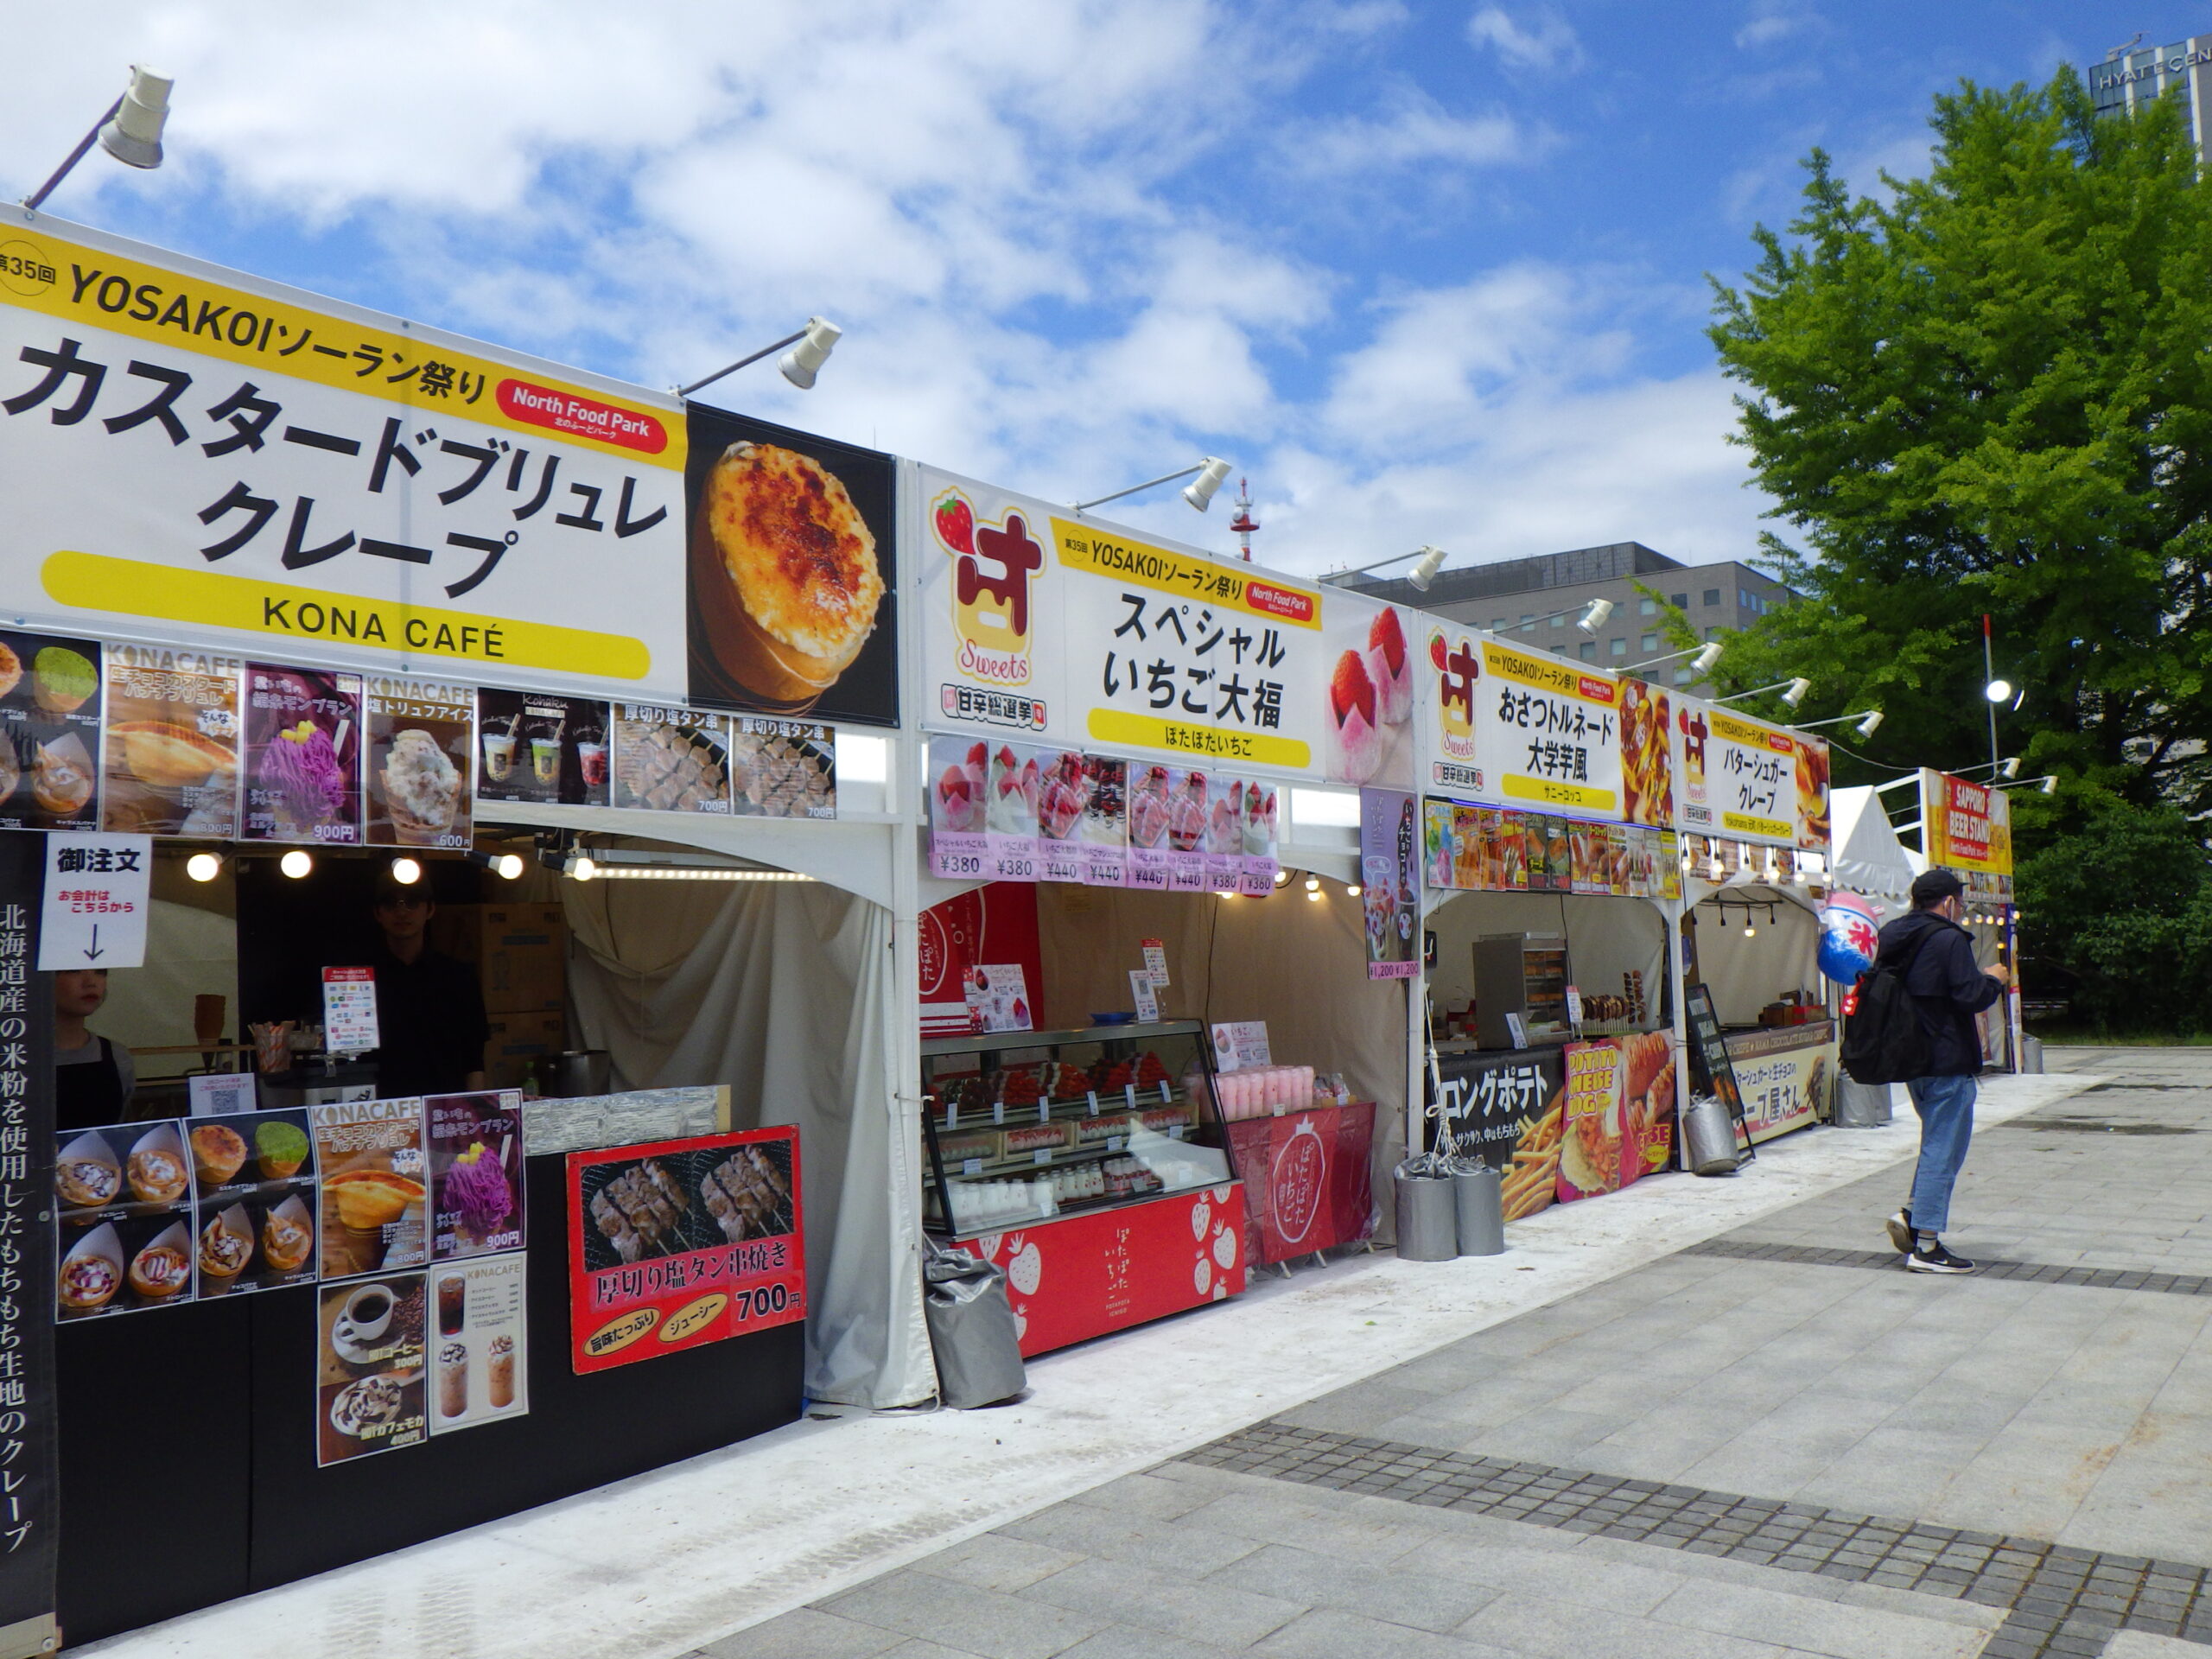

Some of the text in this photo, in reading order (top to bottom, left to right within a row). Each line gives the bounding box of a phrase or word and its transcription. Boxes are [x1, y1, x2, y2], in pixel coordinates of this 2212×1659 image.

[71, 263, 486, 405] YOSAKOIソーラン祭り
[512, 387, 650, 436] North Food Park
[2, 337, 668, 539] カスタードブリュレ
[196, 480, 519, 599] クレープ
[1092, 540, 1243, 601] YOSAKOIソーラン祭り
[1251, 586, 1307, 612] North Food Park
[263, 598, 505, 658] KONA CAFÉ
[1114, 593, 1286, 669] スペシャル
[961, 639, 1027, 679] Sweets
[1502, 655, 1578, 690] YOSAKOIソーラン祭り
[522, 693, 569, 709] Kohaku
[1103, 651, 1281, 729] いちご大福
[367, 697, 474, 722] 塩トリュフアイス
[624, 704, 718, 731] 厚切り塩タン串
[958, 690, 1032, 721] 甘辛総選挙
[1498, 686, 1614, 746] おさつトルネード
[741, 718, 826, 741] 厚切り塩タン串
[1444, 729, 1473, 756] Sweets
[1527, 737, 1587, 782] 大学芋風
[1724, 747, 1788, 784] バターシュガー
[698, 799, 728, 814] 700円
[1738, 784, 1777, 815] クレープ
[1956, 784, 1986, 814] SAPPORO
[807, 806, 835, 819] 700円
[200, 822, 233, 835] 800円
[314, 824, 354, 840] 900円
[1949, 810, 1991, 843] BEER STAND
[439, 835, 471, 848] 600円
[57, 848, 141, 873] 御注文
[940, 855, 980, 873] ¥380
[997, 859, 1033, 876] ¥380
[1046, 862, 1077, 879] ¥440
[1090, 864, 1120, 880] ¥440
[1135, 869, 1163, 884] ¥440
[1175, 873, 1201, 887] ¥440
[1212, 874, 1236, 888] ¥380
[1248, 876, 1271, 890] ¥360
[58, 890, 110, 902] お会計は
[71, 901, 135, 913] こちらから
[1370, 964, 1394, 978] ¥1,200
[1395, 963, 1419, 976] ¥1,200
[1735, 1063, 1796, 1089] ターシュガーと生チョコの
[1440, 1064, 1548, 1121] ロングポテト
[313, 1099, 422, 1124] KONACAFE
[0, 903, 33, 1554] 北海道産の米粉を使用したもちもち生地のクレープ
[486, 1230, 519, 1247] 900円
[397, 1251, 424, 1262] 800円
[467, 1264, 521, 1280] KONACAFE
[596, 1242, 787, 1305] 厚切り塩タン串焼き
[737, 1283, 801, 1322] 700円
[670, 1300, 718, 1335] ジューシー
[590, 1310, 655, 1353] 旨味たっぷり
